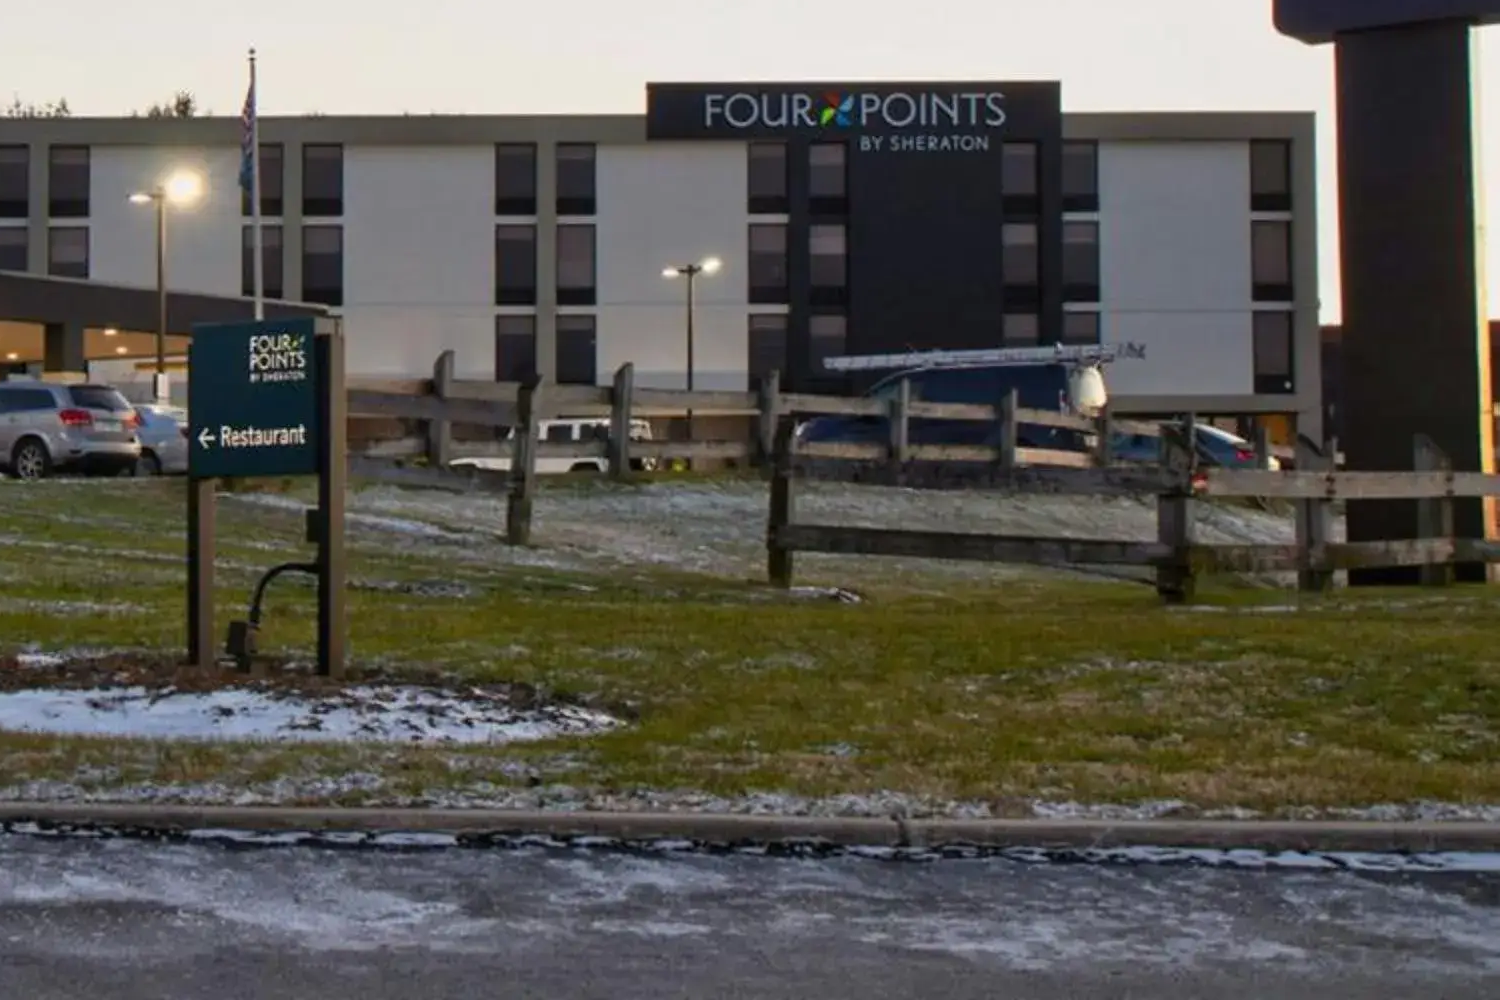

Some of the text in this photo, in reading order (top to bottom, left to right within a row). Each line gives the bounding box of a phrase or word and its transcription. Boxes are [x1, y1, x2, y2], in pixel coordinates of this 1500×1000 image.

[705, 92, 1006, 128] FOUR POINTS
[860, 135, 989, 151] BY SHERATON
[250, 334, 291, 352] FOUR
[250, 351, 306, 371] POINTS
[220, 424, 306, 447] Restaurant
